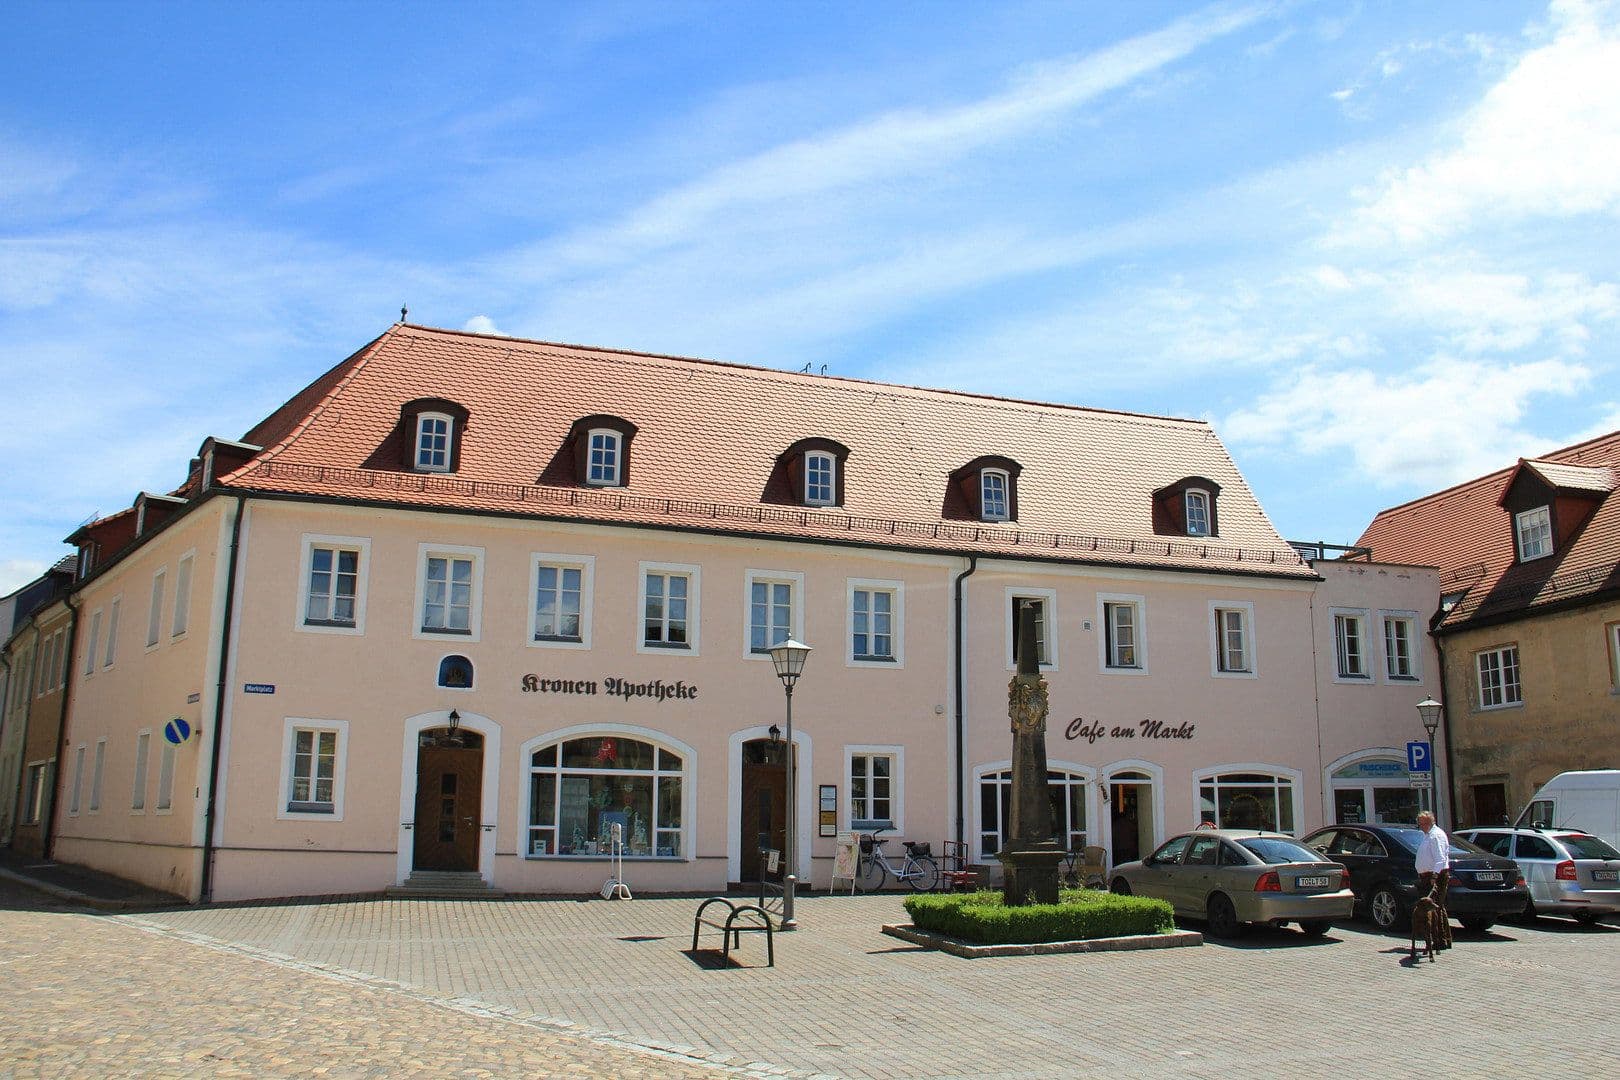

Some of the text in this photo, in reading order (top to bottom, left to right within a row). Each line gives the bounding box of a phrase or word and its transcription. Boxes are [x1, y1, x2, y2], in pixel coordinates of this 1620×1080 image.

[246, 685, 273, 693] Marktplatz
[522, 673, 698, 702] Kronen Apotheke
[1065, 717, 1195, 744] Cafe am Markt
[1412, 746, 1425, 768] P
